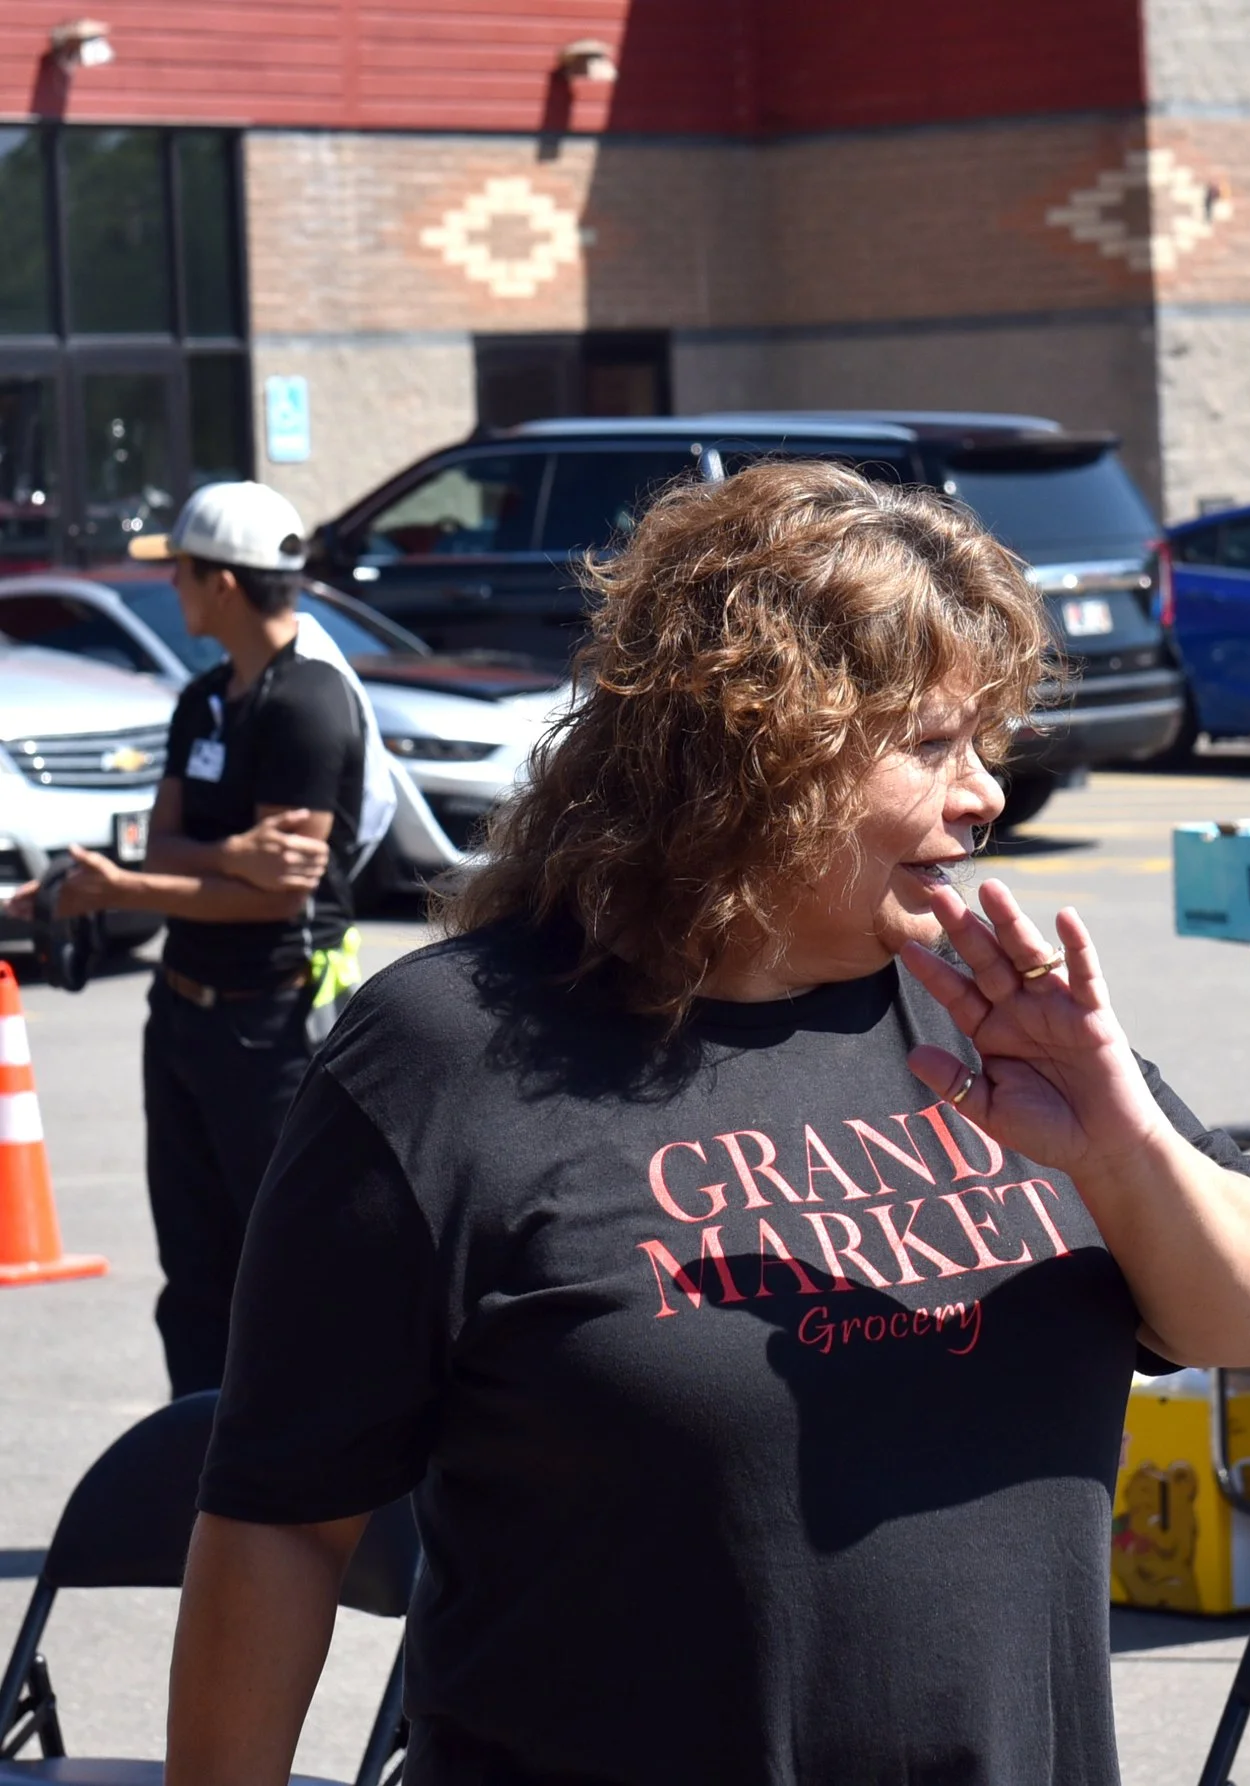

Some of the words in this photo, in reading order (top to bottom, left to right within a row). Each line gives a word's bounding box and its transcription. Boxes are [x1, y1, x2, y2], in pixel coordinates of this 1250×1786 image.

[648, 1099, 1004, 1225] GRAND
[635, 1178, 1074, 1320] MARKET
[797, 1298, 984, 1356] Grocery
